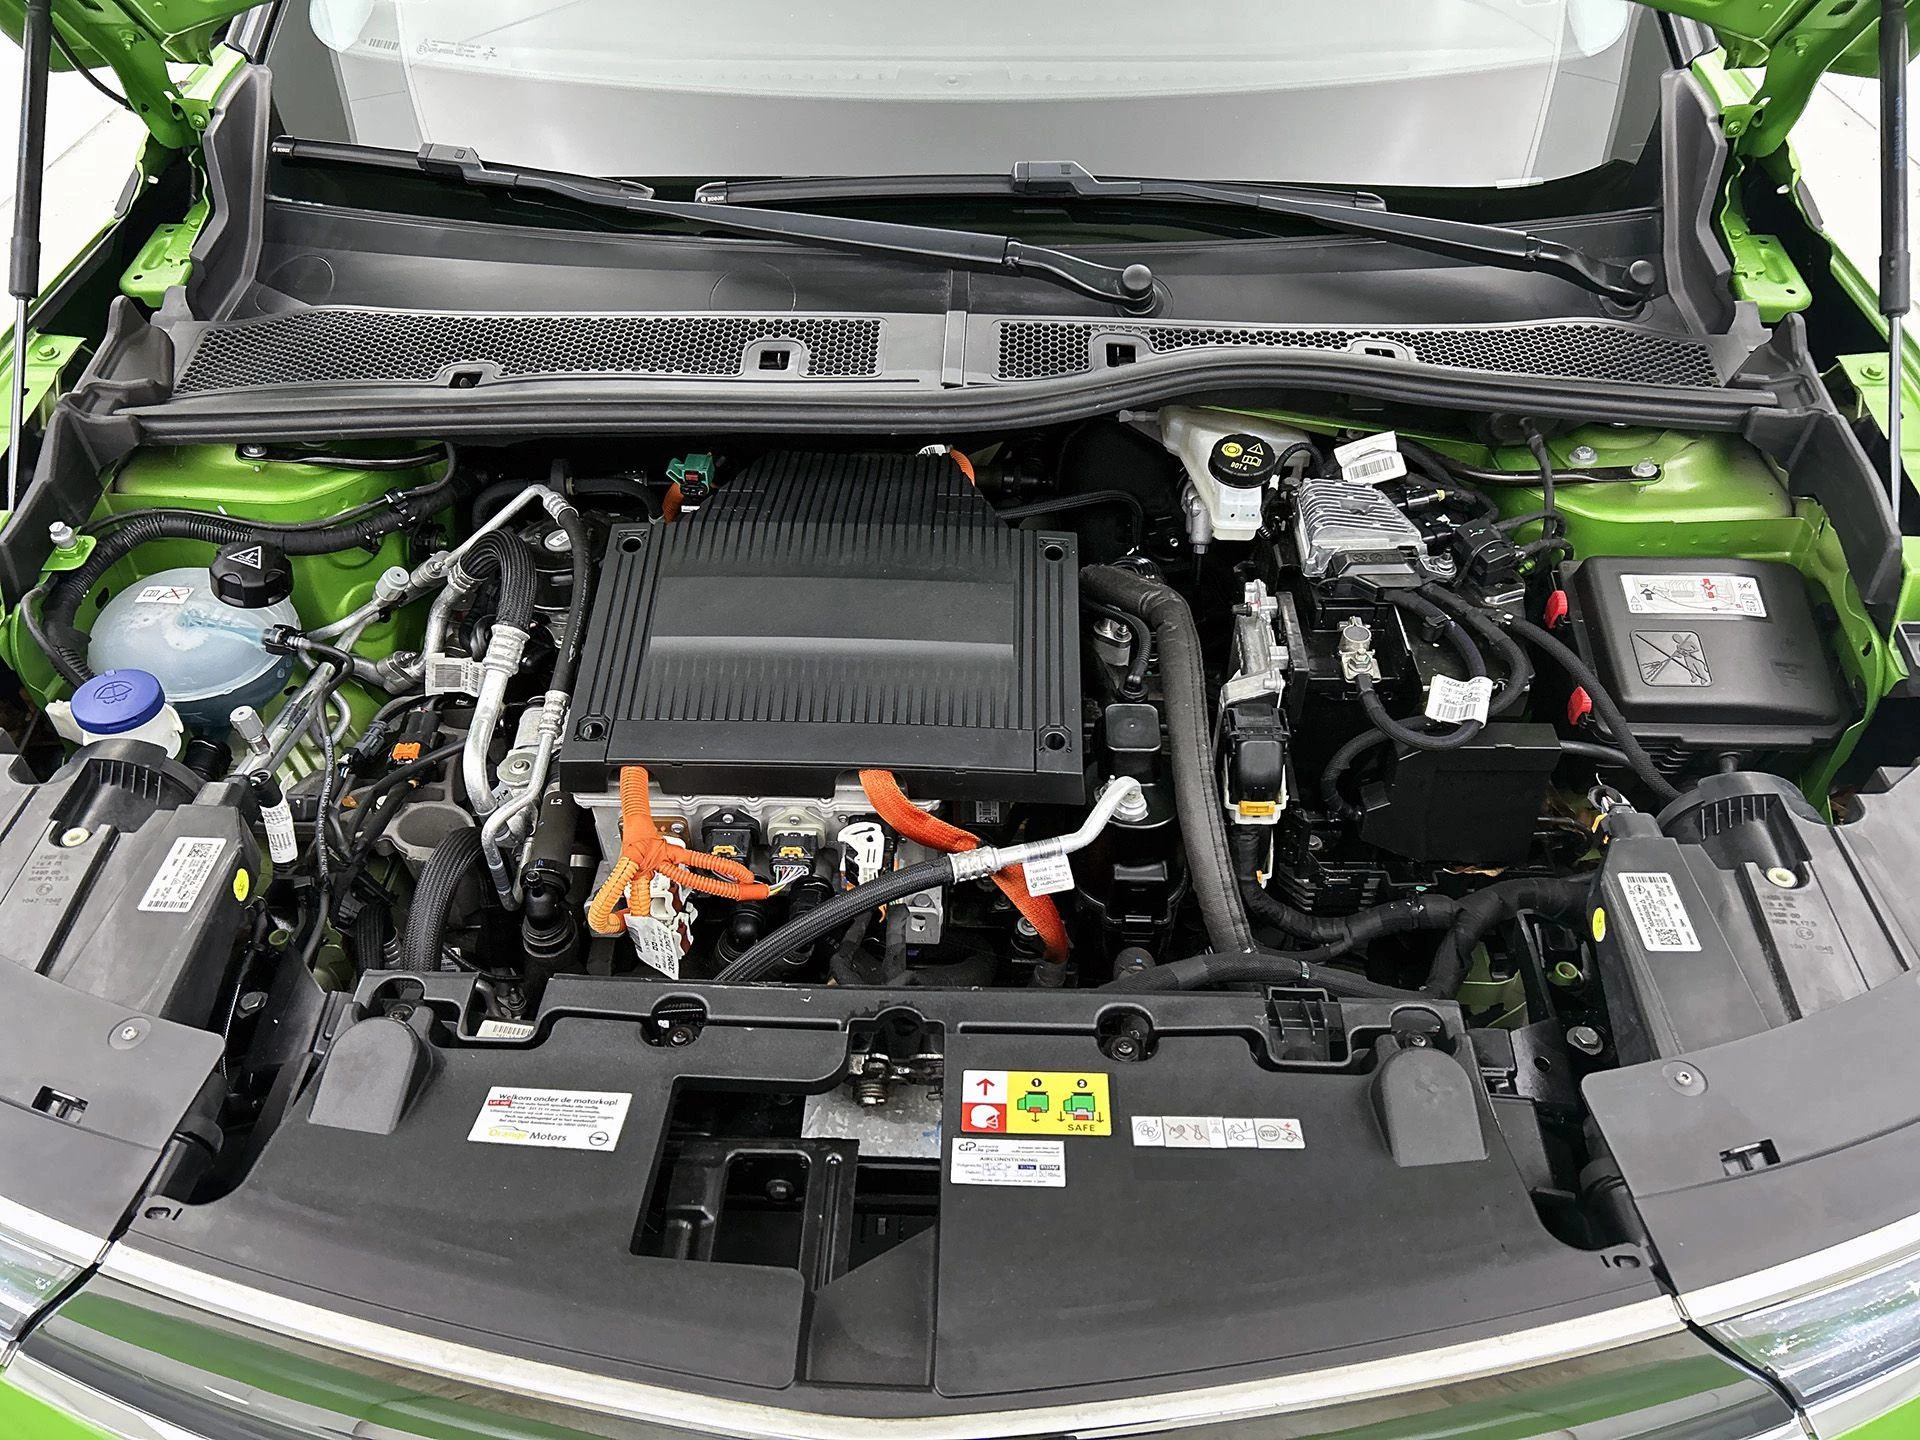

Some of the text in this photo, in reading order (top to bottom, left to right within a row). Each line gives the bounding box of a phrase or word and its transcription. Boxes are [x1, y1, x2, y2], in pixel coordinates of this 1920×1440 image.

[1231, 461, 1243, 469] DOT
[499, 1093, 532, 1101] Welkom
[1067, 1124, 1095, 1132] SAFE
[529, 1132, 567, 1141] Motors
